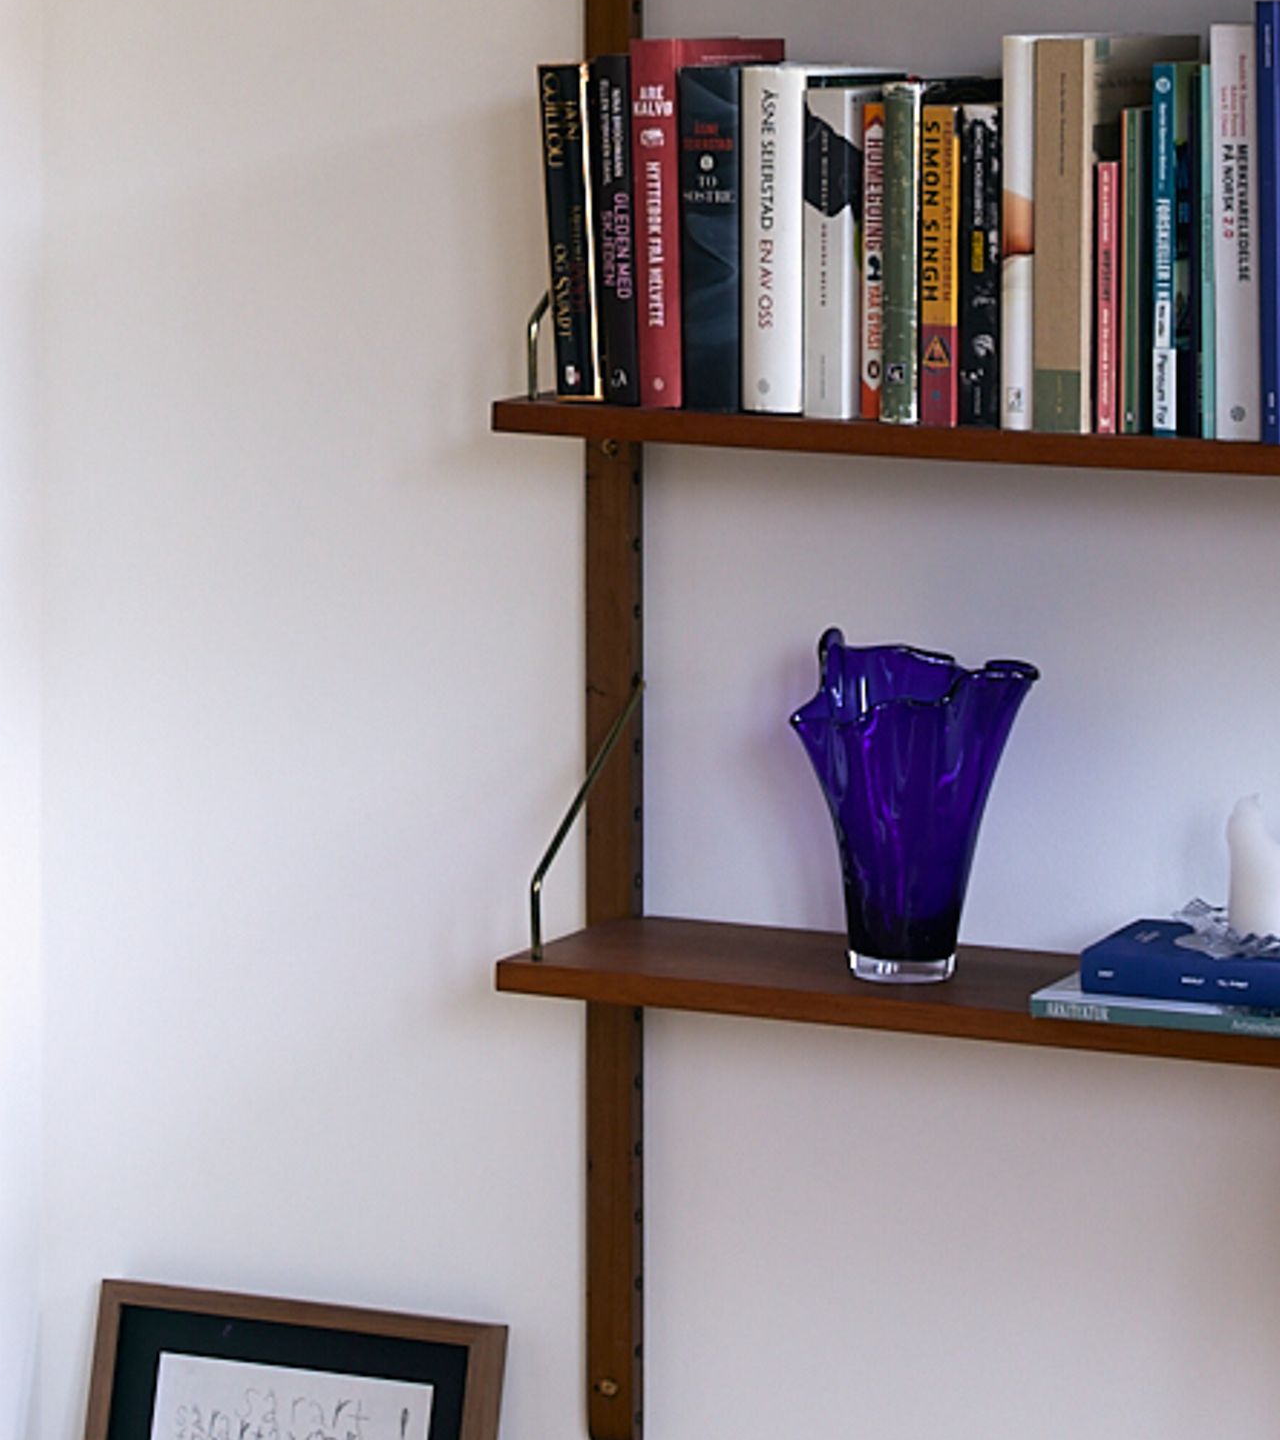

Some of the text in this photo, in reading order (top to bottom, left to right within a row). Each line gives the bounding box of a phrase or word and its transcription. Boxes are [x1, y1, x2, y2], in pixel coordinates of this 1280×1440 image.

[542, 72, 564, 167] GUILLOU
[564, 99, 578, 142] JAN
[758, 88, 779, 329] ÅSNE SEIERSTAD EN AV OSS
[923, 120, 940, 303] SIMON SINGH
[1221, 144, 1237, 239] PÅ NORSK 2.0
[1236, 144, 1250, 282] MERKEVARELEDELSE
[554, 243, 573, 342] OG SVART
[601, 210, 615, 287] SKJEDEN
[613, 192, 631, 299] GLEDEN MED
[645, 161, 665, 327] HYTTEBOK FRÅ HELVETE
[234, 1387, 279, 1425] så
[291, 1396, 370, 1431] rart
